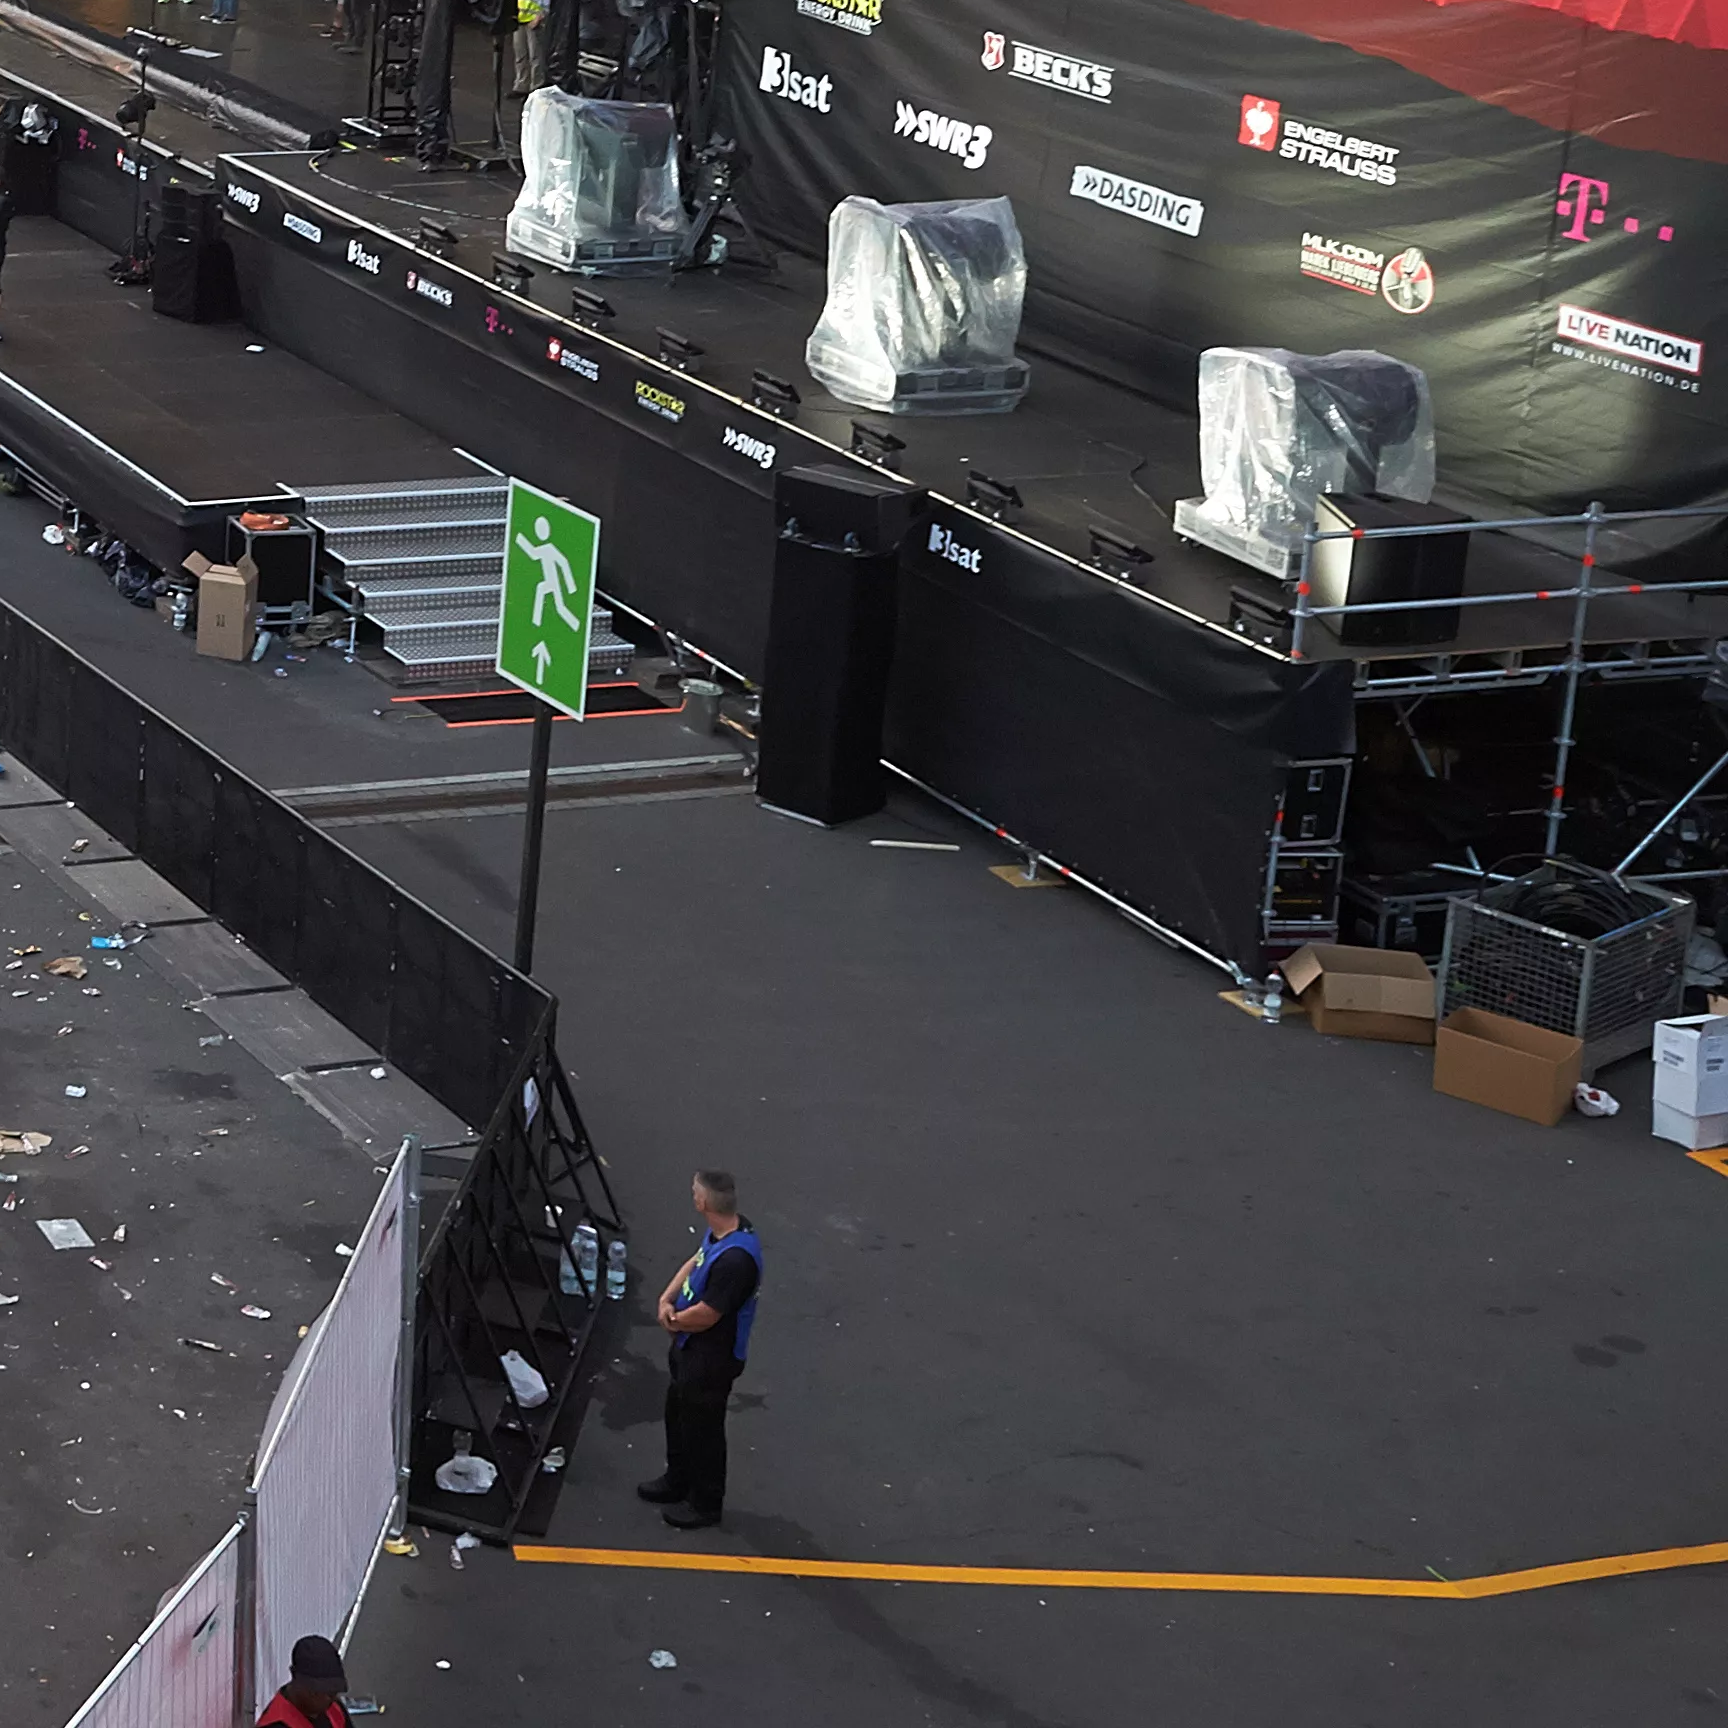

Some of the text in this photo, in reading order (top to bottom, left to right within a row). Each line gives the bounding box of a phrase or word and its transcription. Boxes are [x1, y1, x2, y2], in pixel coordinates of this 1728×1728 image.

[838, 9, 873, 34] DRINK
[759, 45, 834, 113] 3sat
[1279, 139, 1397, 186] STRAUSS
[1283, 120, 1400, 165] ENGELBERT
[1302, 232, 1384, 268] MLK.COM
[1567, 315, 1691, 363] LIVE NATION
[928, 523, 982, 573] 3sat
